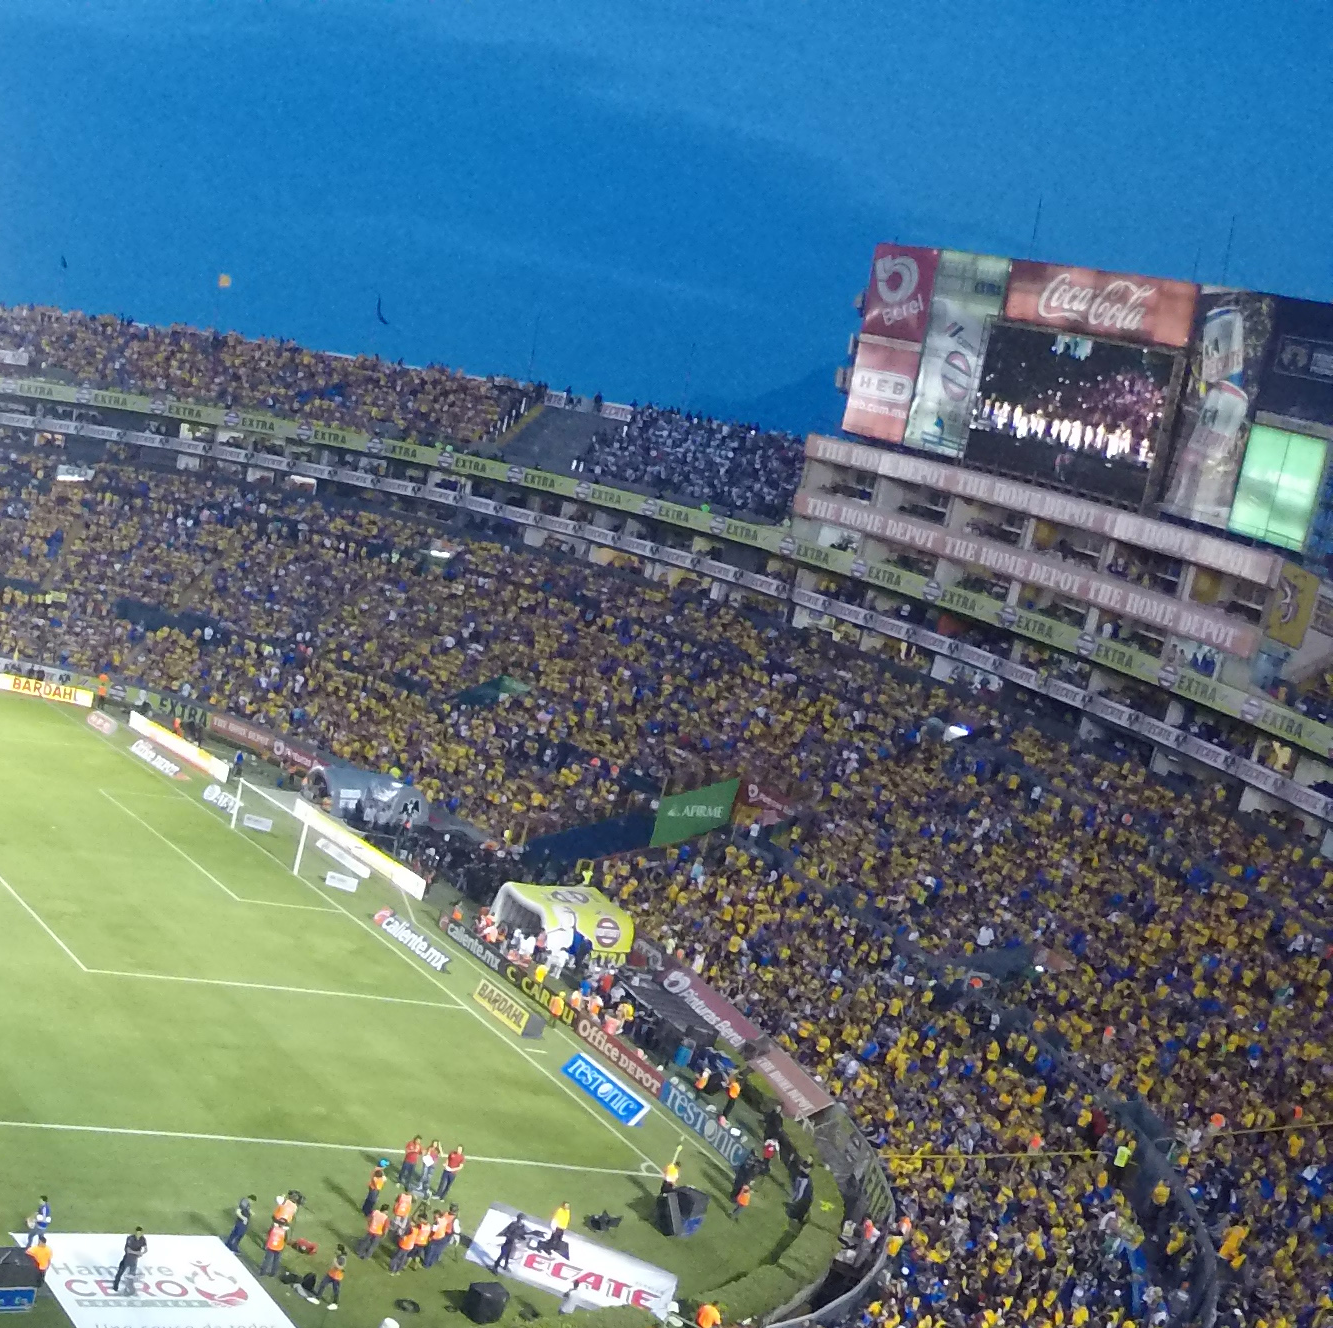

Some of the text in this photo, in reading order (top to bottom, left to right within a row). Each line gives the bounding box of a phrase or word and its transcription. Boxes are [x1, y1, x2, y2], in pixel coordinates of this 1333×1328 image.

[883, 294, 924, 326] Berel
[167, 404, 202, 420] EXTRA
[241, 418, 275, 432] EXTRA
[313, 430, 347, 445] EXTRA
[523, 472, 555, 489] EXTRA
[658, 505, 690, 523] EXTRA
[806, 498, 939, 550] THE HOME DEPOT
[725, 523, 759, 541] EXTRA
[796, 545, 830, 565] EXTRA
[944, 536, 1079, 593] THE HOME DEPOT
[867, 565, 903, 587] EXTRA
[940, 590, 977, 612] EXTRA
[1088, 579, 1239, 648] THE HOME DEPOT
[12, 676, 80, 702] BARDAHL
[681, 805, 724, 819] AFIRME
[382, 915, 450, 972] caliente.mx
[447, 922, 501, 971] caliente.mx
[480, 980, 526, 1029] BARDAHL
[577, 1019, 662, 1096] Office DEPOT
[64, 1279, 189, 1297] CERO
[523, 1252, 661, 1310] ECATE
